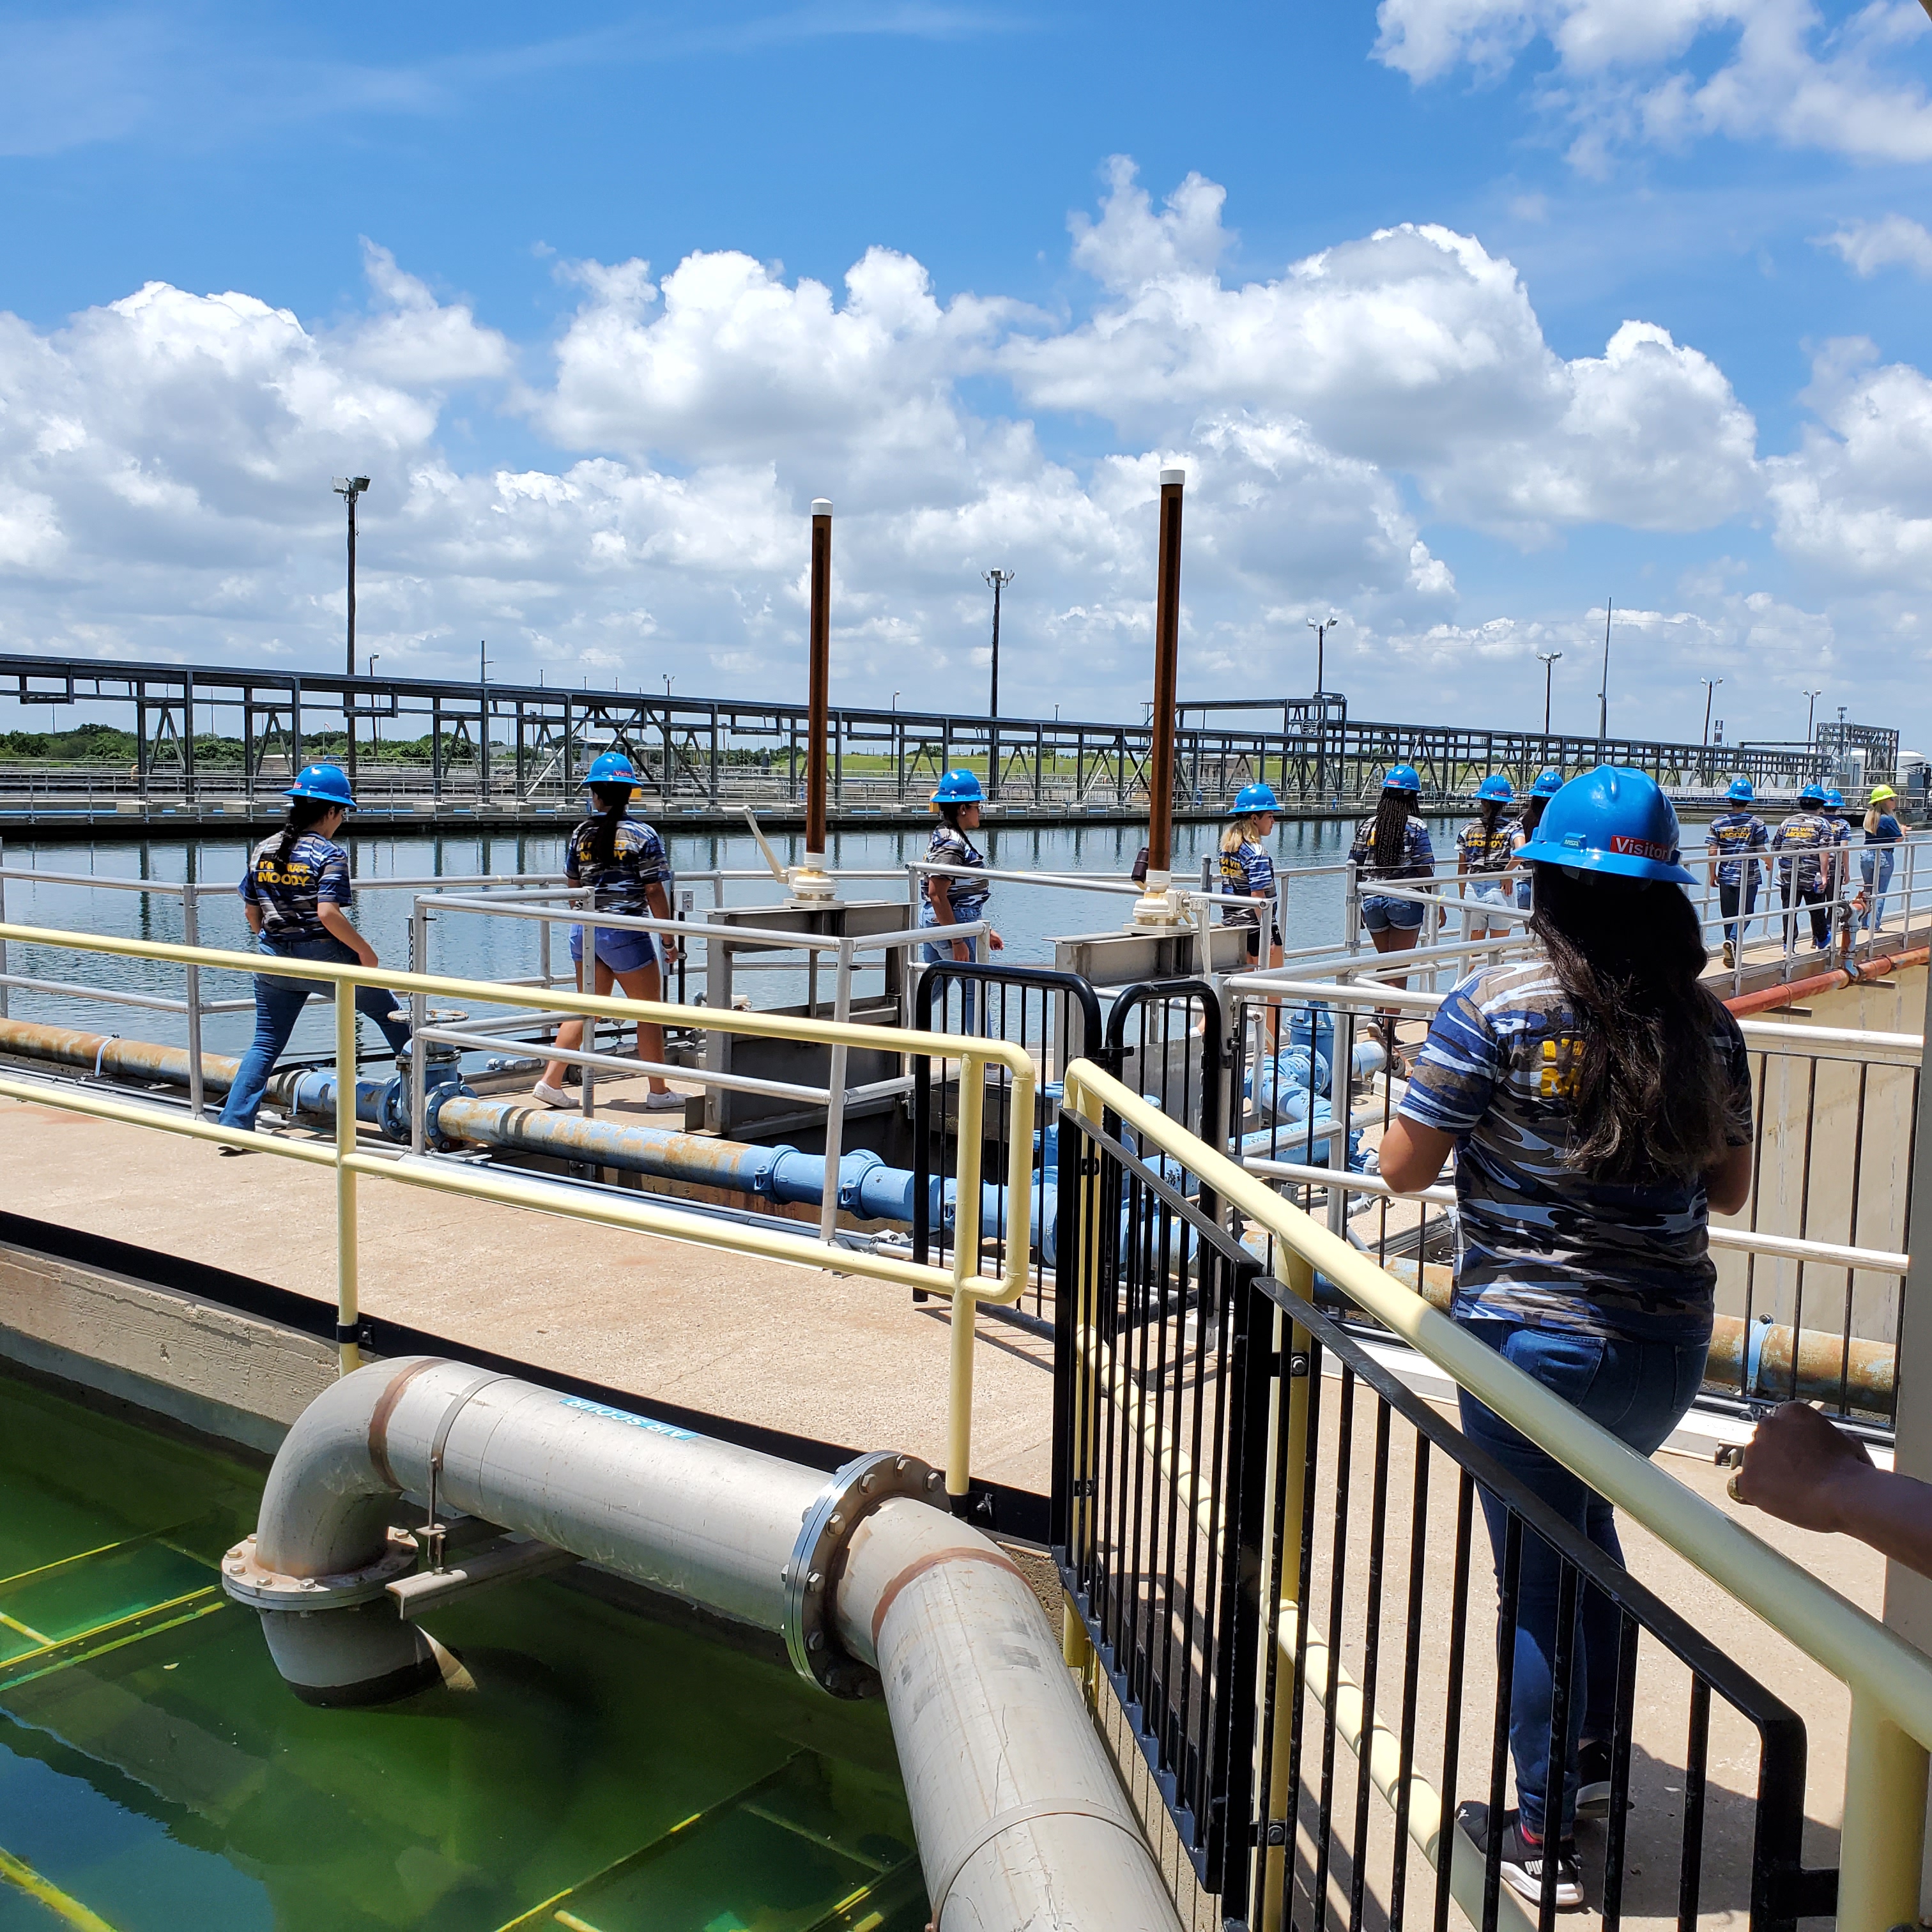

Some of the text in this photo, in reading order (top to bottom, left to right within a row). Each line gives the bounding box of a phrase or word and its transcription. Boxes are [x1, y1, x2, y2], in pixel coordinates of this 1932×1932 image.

[1616, 838, 1667, 860] Visitor
[258, 872, 310, 886] MOODY
[567, 1400, 692, 1437] AIR SCOUR
